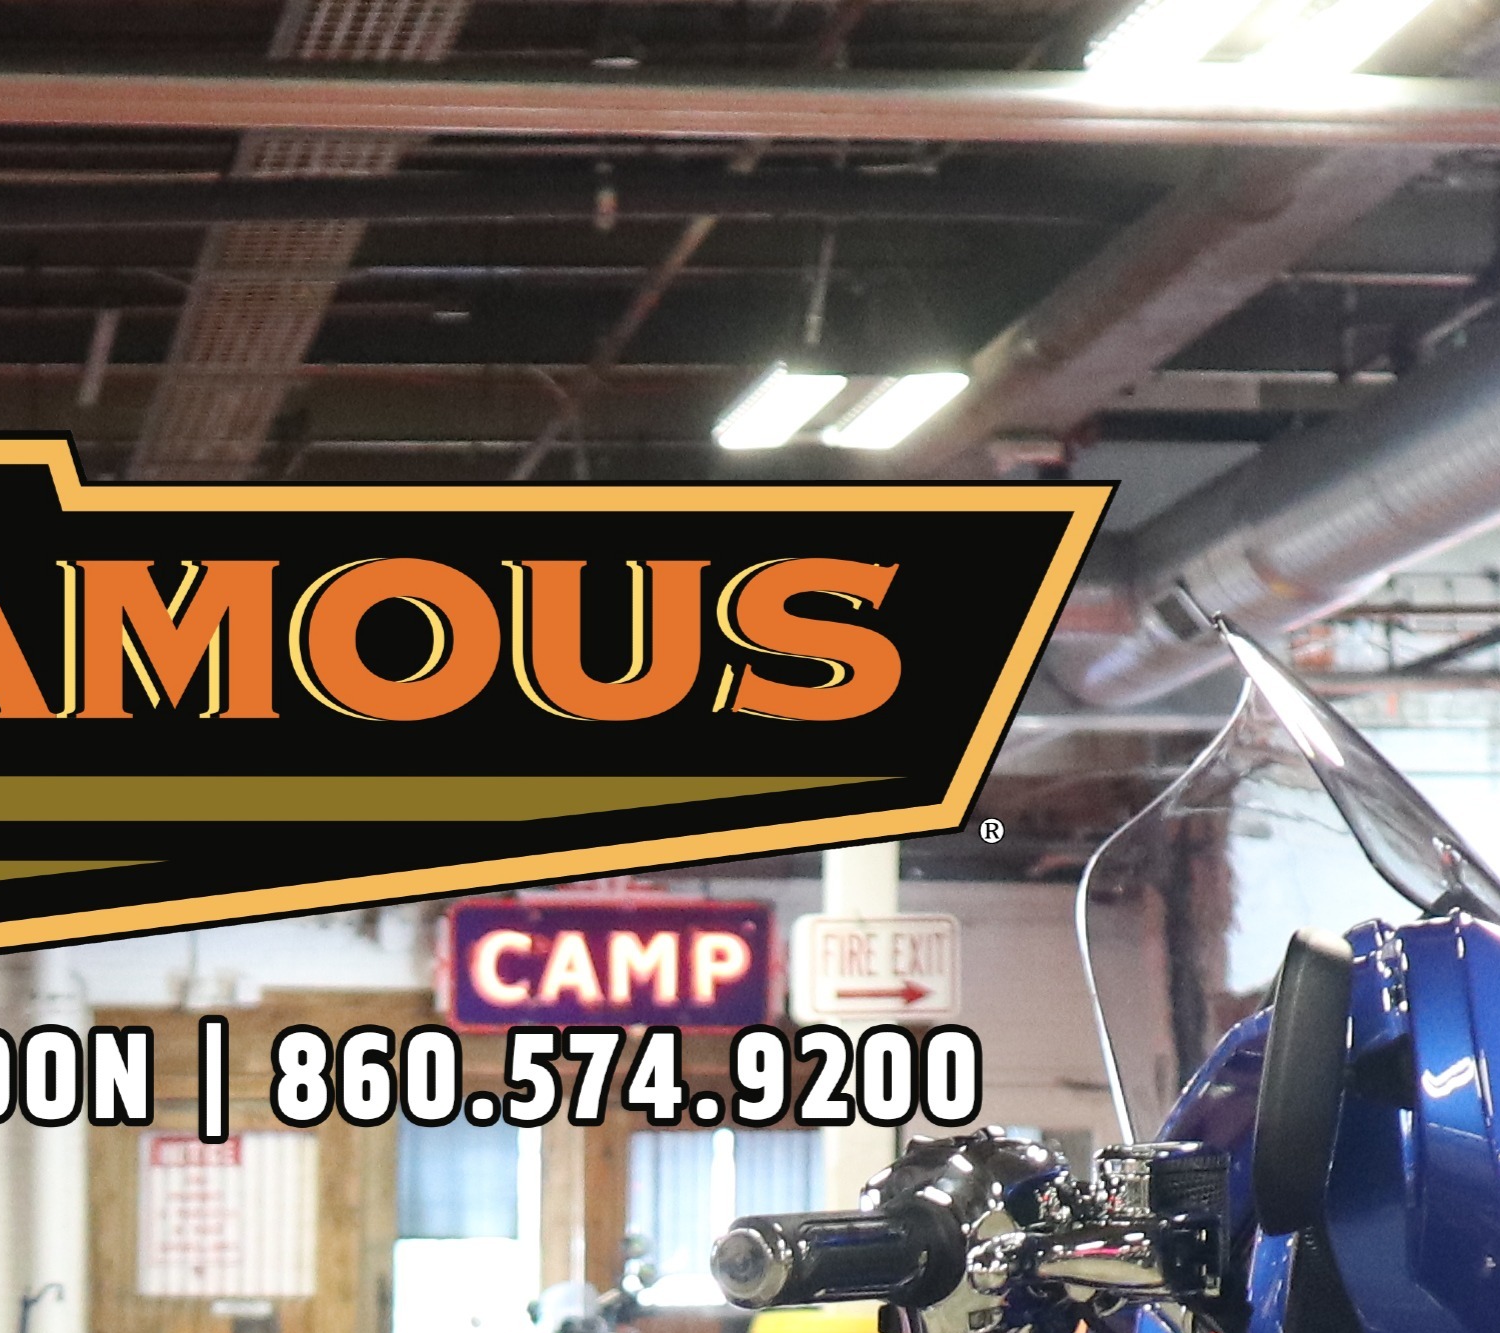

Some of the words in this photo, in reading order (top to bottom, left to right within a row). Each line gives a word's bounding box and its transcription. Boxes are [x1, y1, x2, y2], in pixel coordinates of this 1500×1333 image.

[469, 928, 755, 1007] CAMP
[823, 933, 878, 977] FIRE
[892, 932, 948, 977] EXIT
